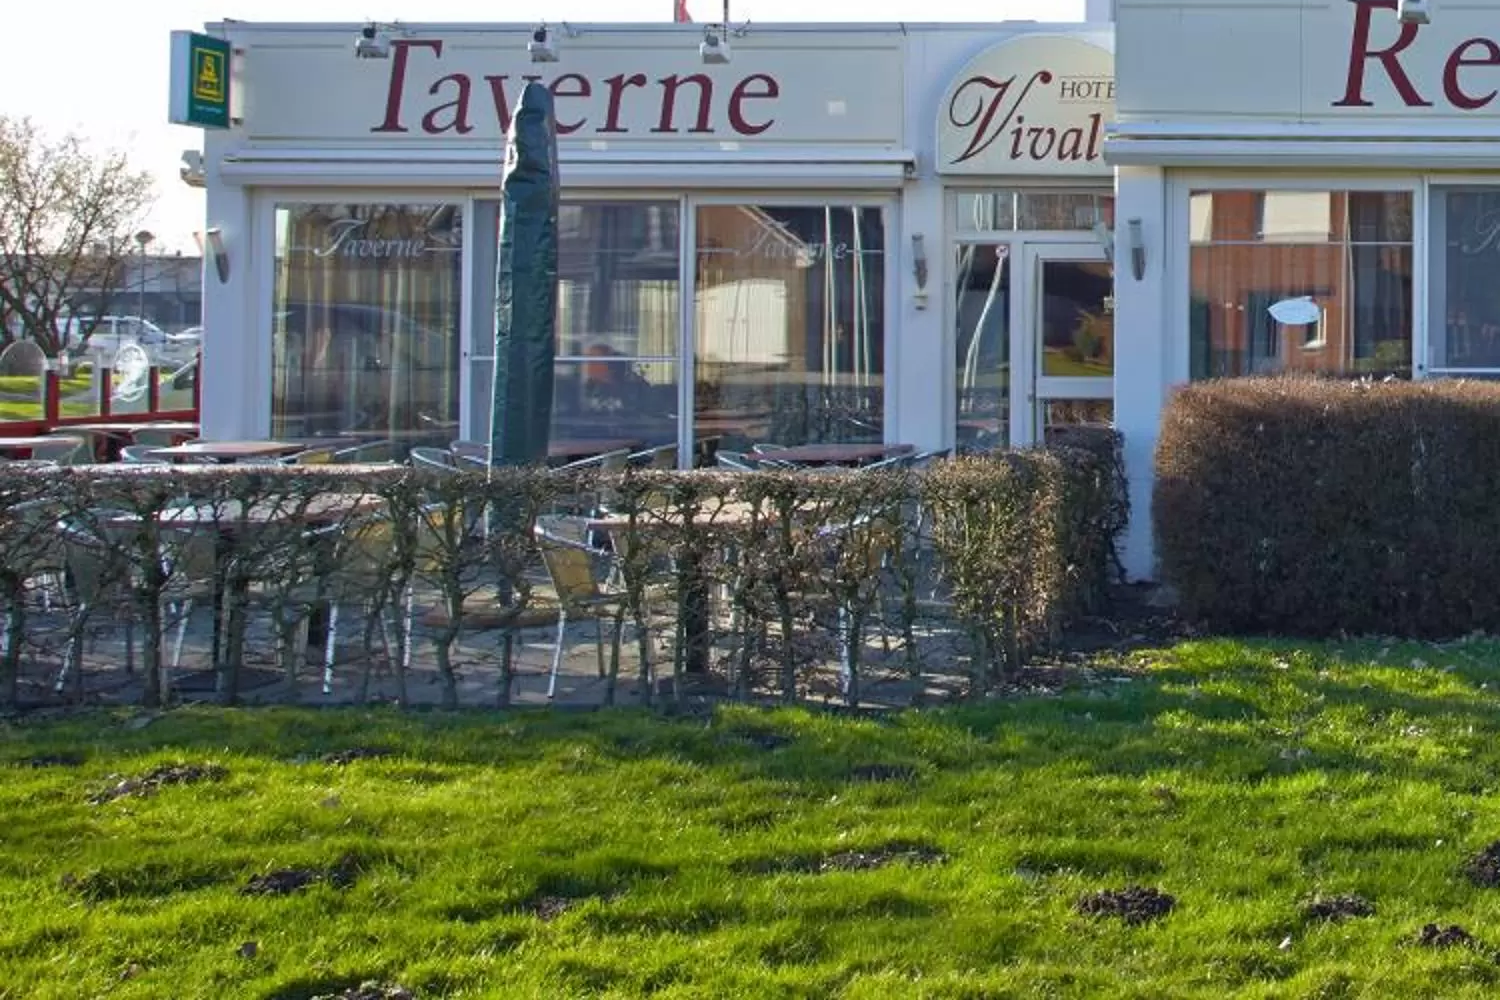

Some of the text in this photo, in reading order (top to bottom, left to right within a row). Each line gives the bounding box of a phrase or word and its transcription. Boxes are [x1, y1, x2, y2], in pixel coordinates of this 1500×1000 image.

[371, 39, 779, 135] Taverne
[949, 70, 1105, 164] Vival
[1059, 81, 1115, 99] HOTE
